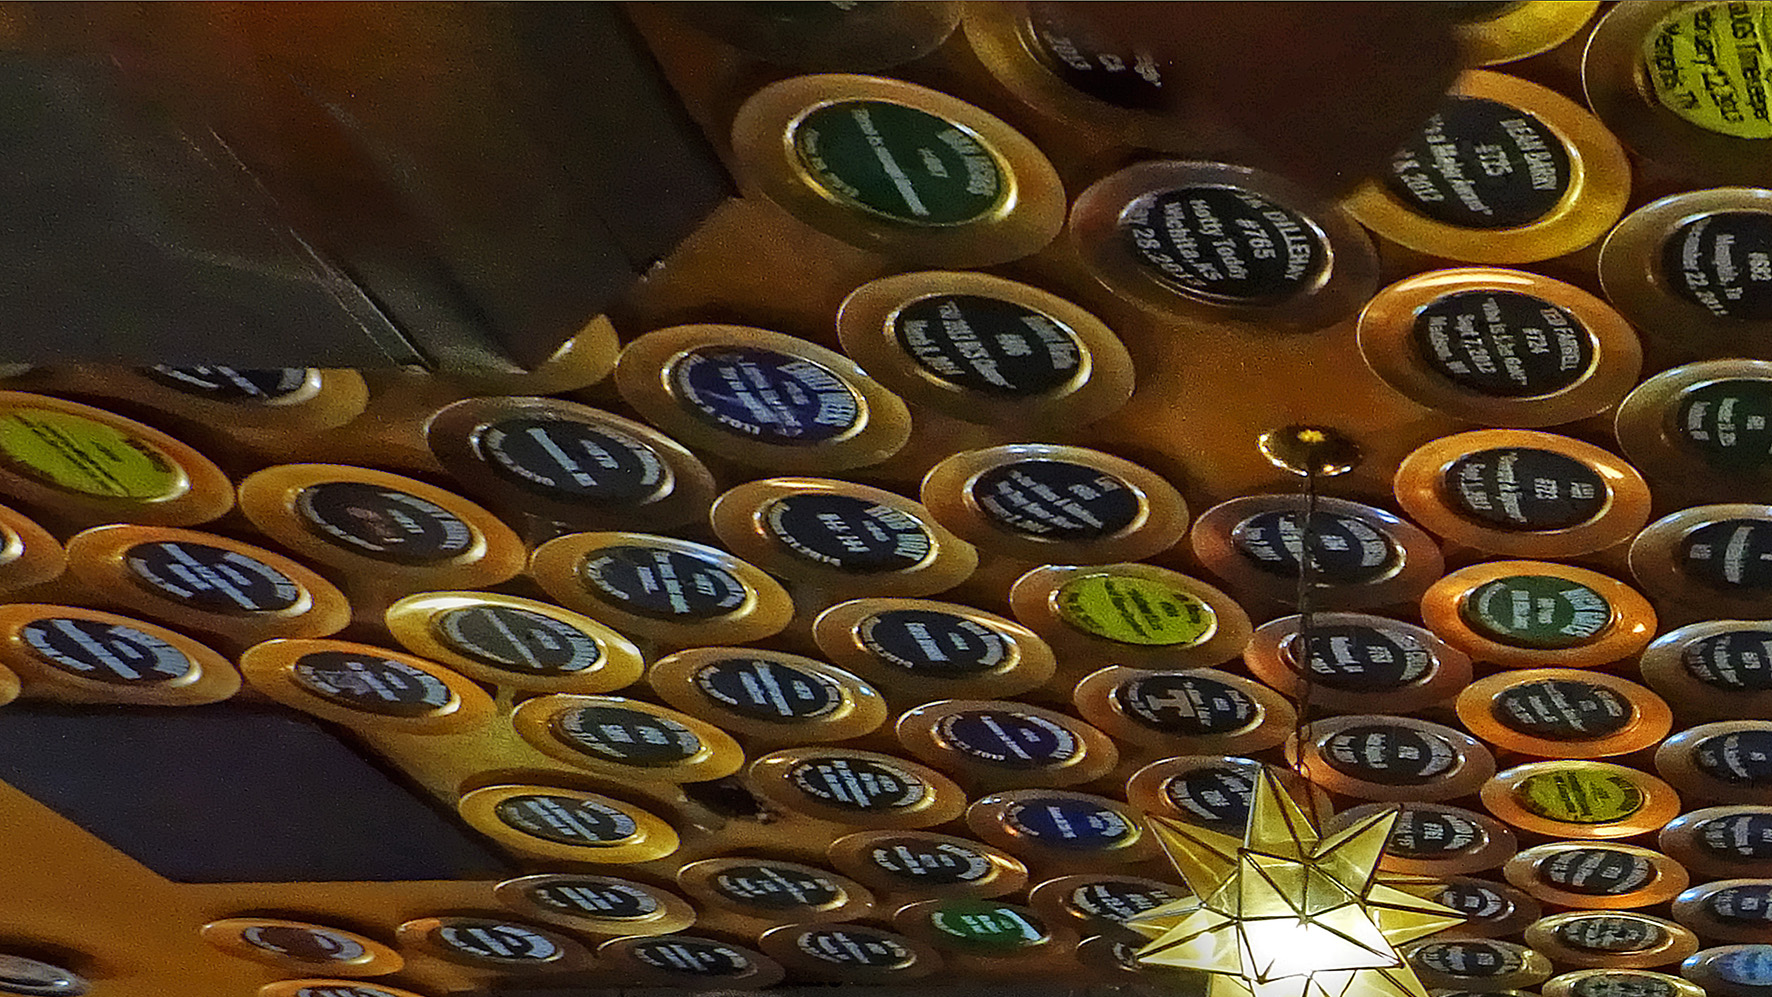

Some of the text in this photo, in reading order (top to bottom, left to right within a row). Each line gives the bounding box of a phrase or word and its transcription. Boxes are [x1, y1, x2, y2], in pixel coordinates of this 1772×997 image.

[1213, 239, 1247, 280] Toddy
[1235, 218, 1276, 260] #765
[1263, 211, 1309, 282] DILLEHAY
[1747, 251, 1772, 281] #682
[1521, 328, 1549, 354] #724
